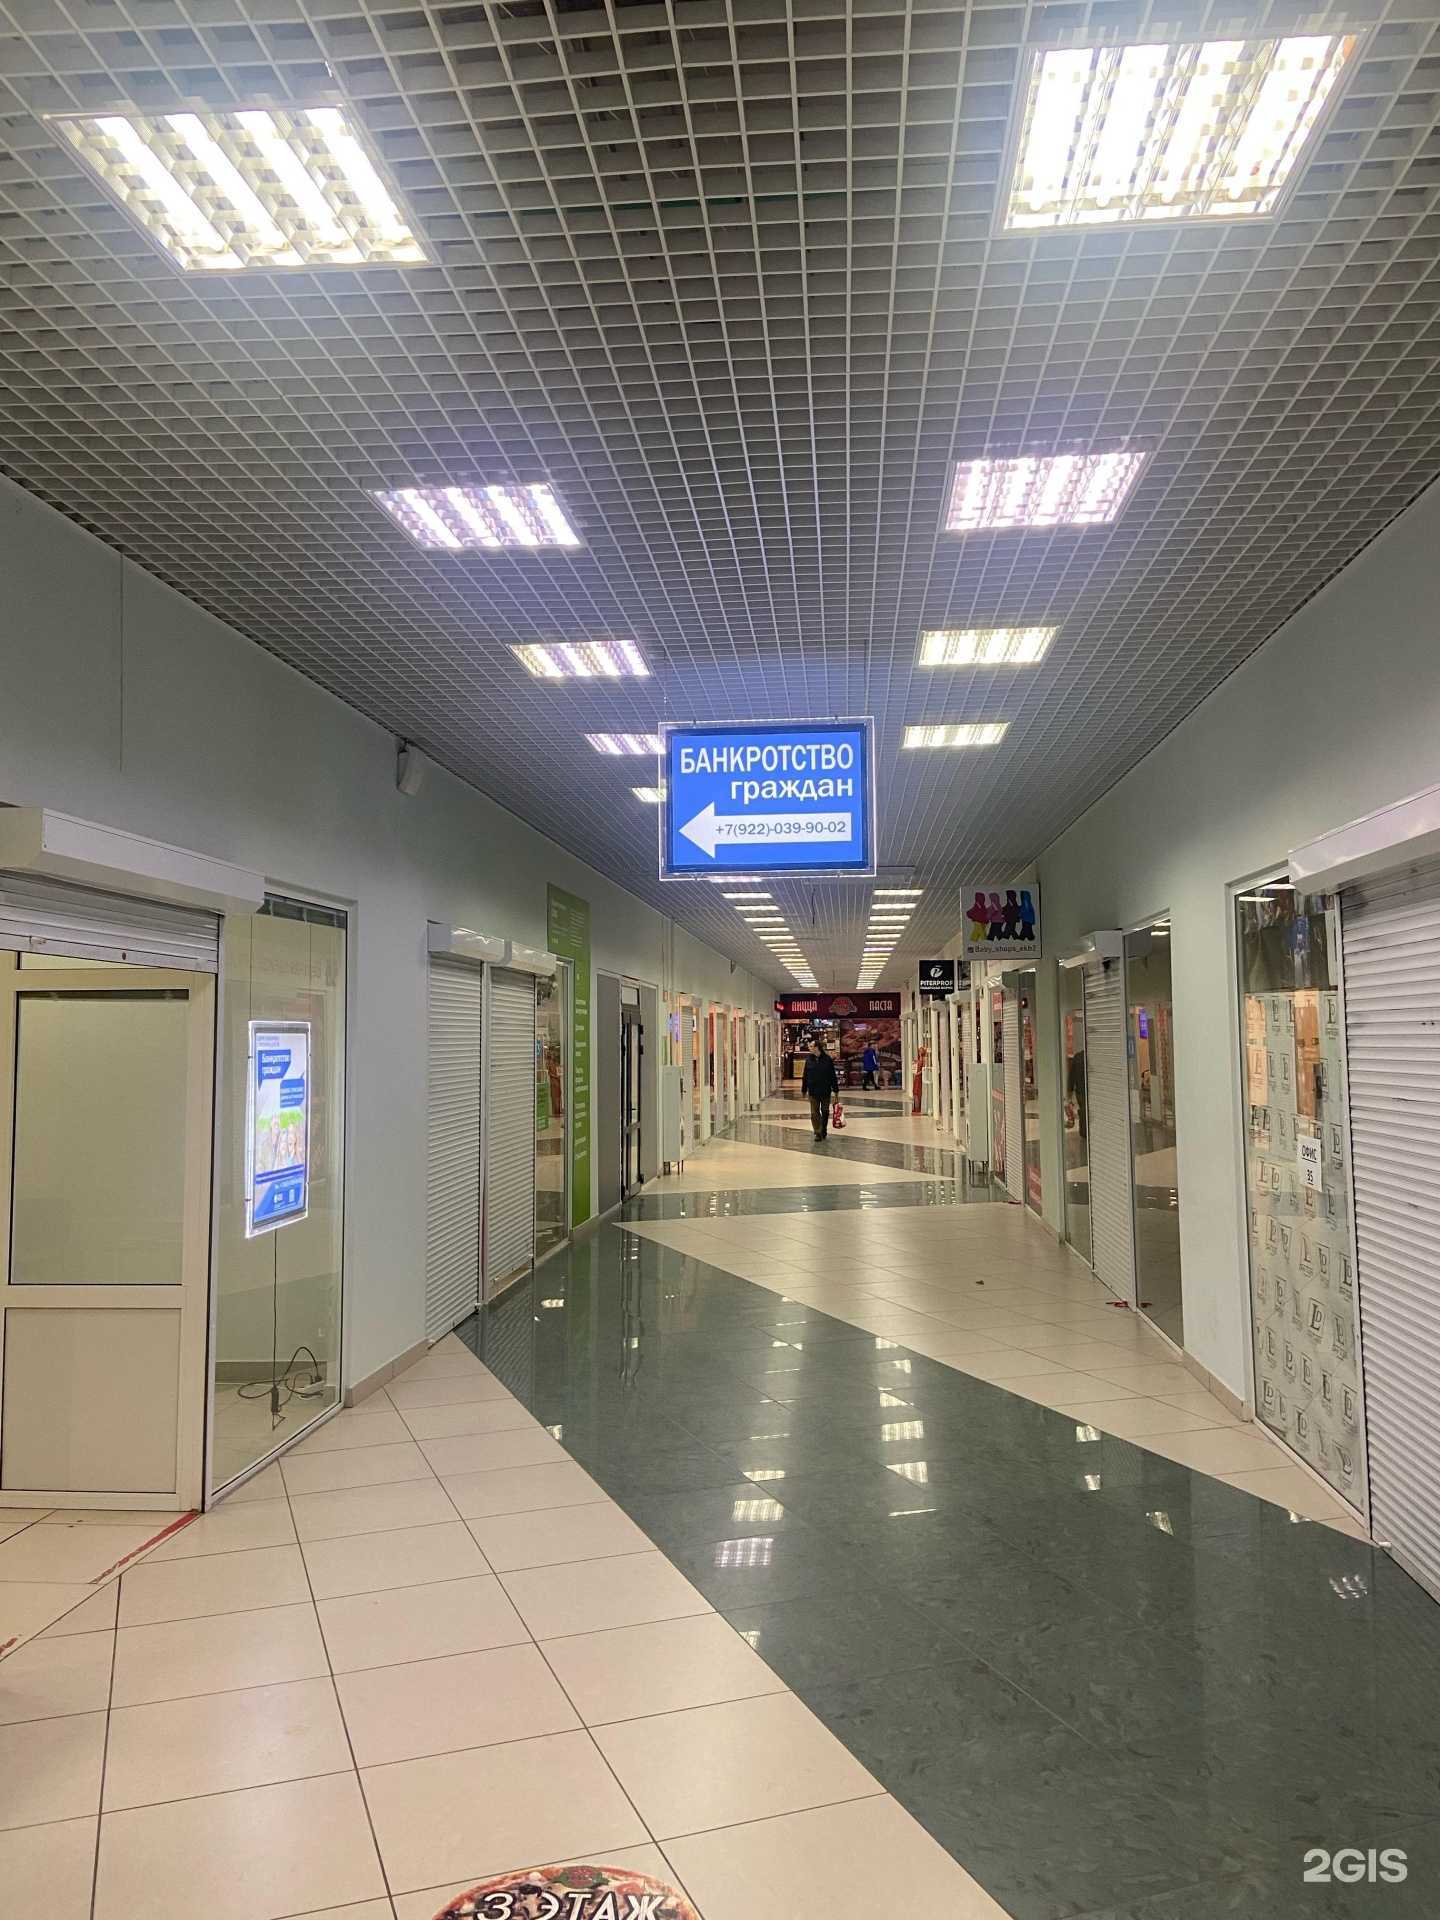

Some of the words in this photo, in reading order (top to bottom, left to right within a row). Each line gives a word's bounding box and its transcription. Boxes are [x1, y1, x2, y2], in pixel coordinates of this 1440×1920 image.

[680, 743, 854, 774] БАНКРОТСТВО
[730, 778, 853, 804] граждан
[715, 820, 846, 837] +7(922)-039-90-02
[869, 1000, 893, 1011] ПАСТА
[1301, 1144, 1317, 1161] ОФИС
[476, 1892, 513, 1920] 3
[536, 1891, 666, 1920] ЭТАЖ
